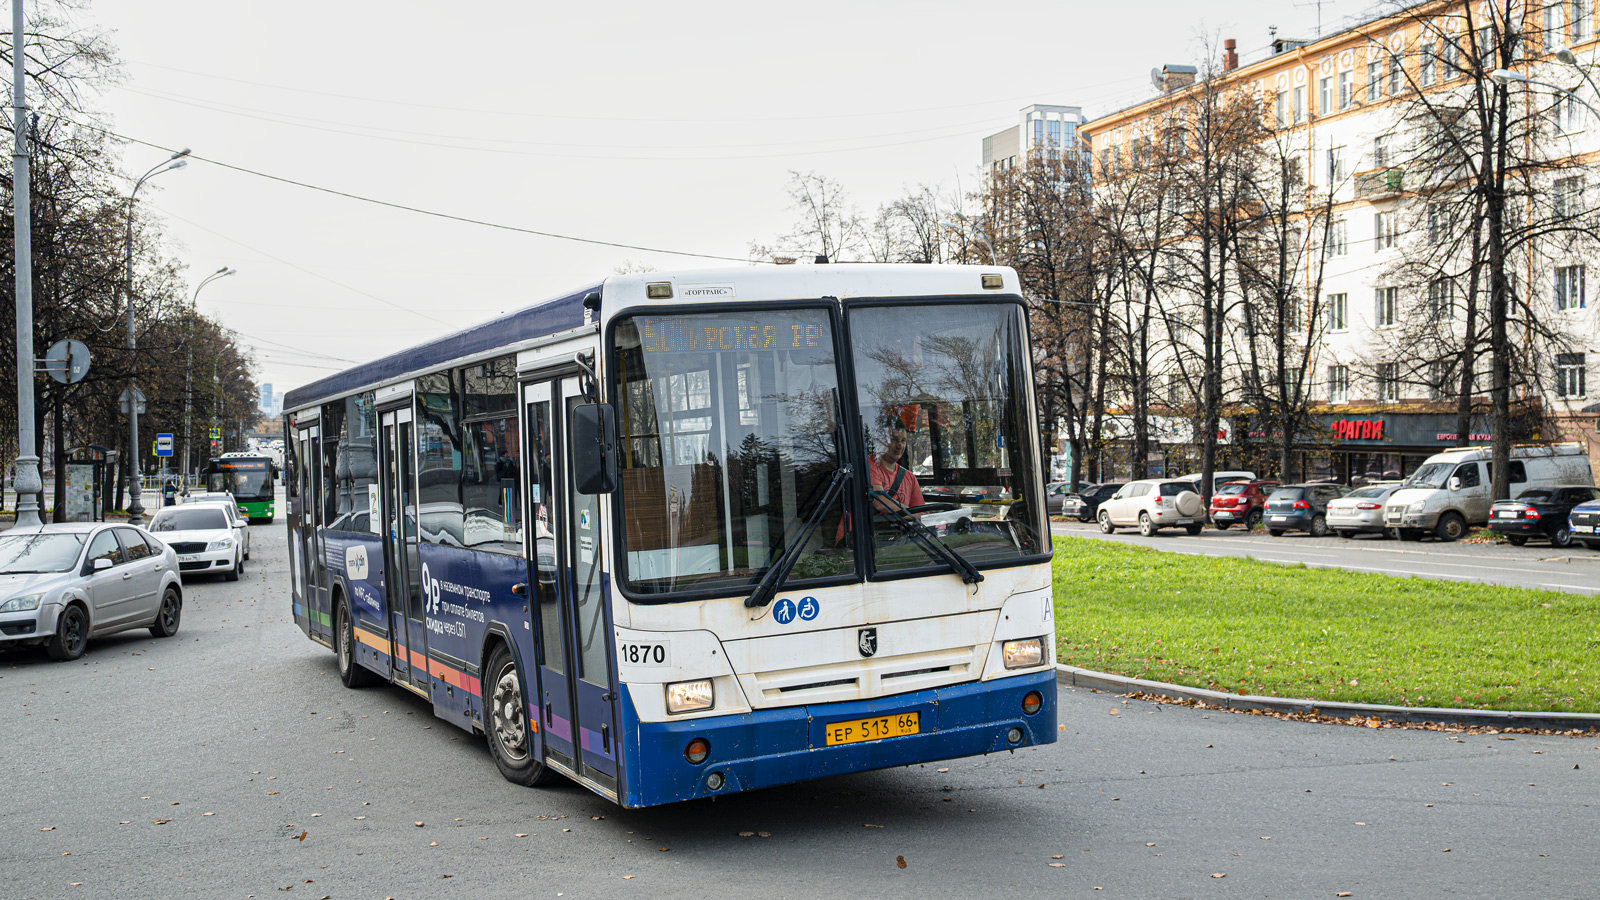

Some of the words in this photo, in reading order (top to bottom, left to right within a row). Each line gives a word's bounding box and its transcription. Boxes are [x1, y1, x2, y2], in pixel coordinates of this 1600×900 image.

[1476, 433, 1493, 441] КУХН
[443, 580, 464, 596] наземном
[464, 586, 491, 605] транспорте
[449, 603, 465, 618] оплате
[465, 603, 485, 623] билетов
[1043, 597, 1053, 621] A
[425, 616, 444, 635] скидка
[443, 621, 456, 637] через
[621, 643, 666, 664] 1870
[861, 718, 889, 738] 513
[898, 714, 913, 729] 66
